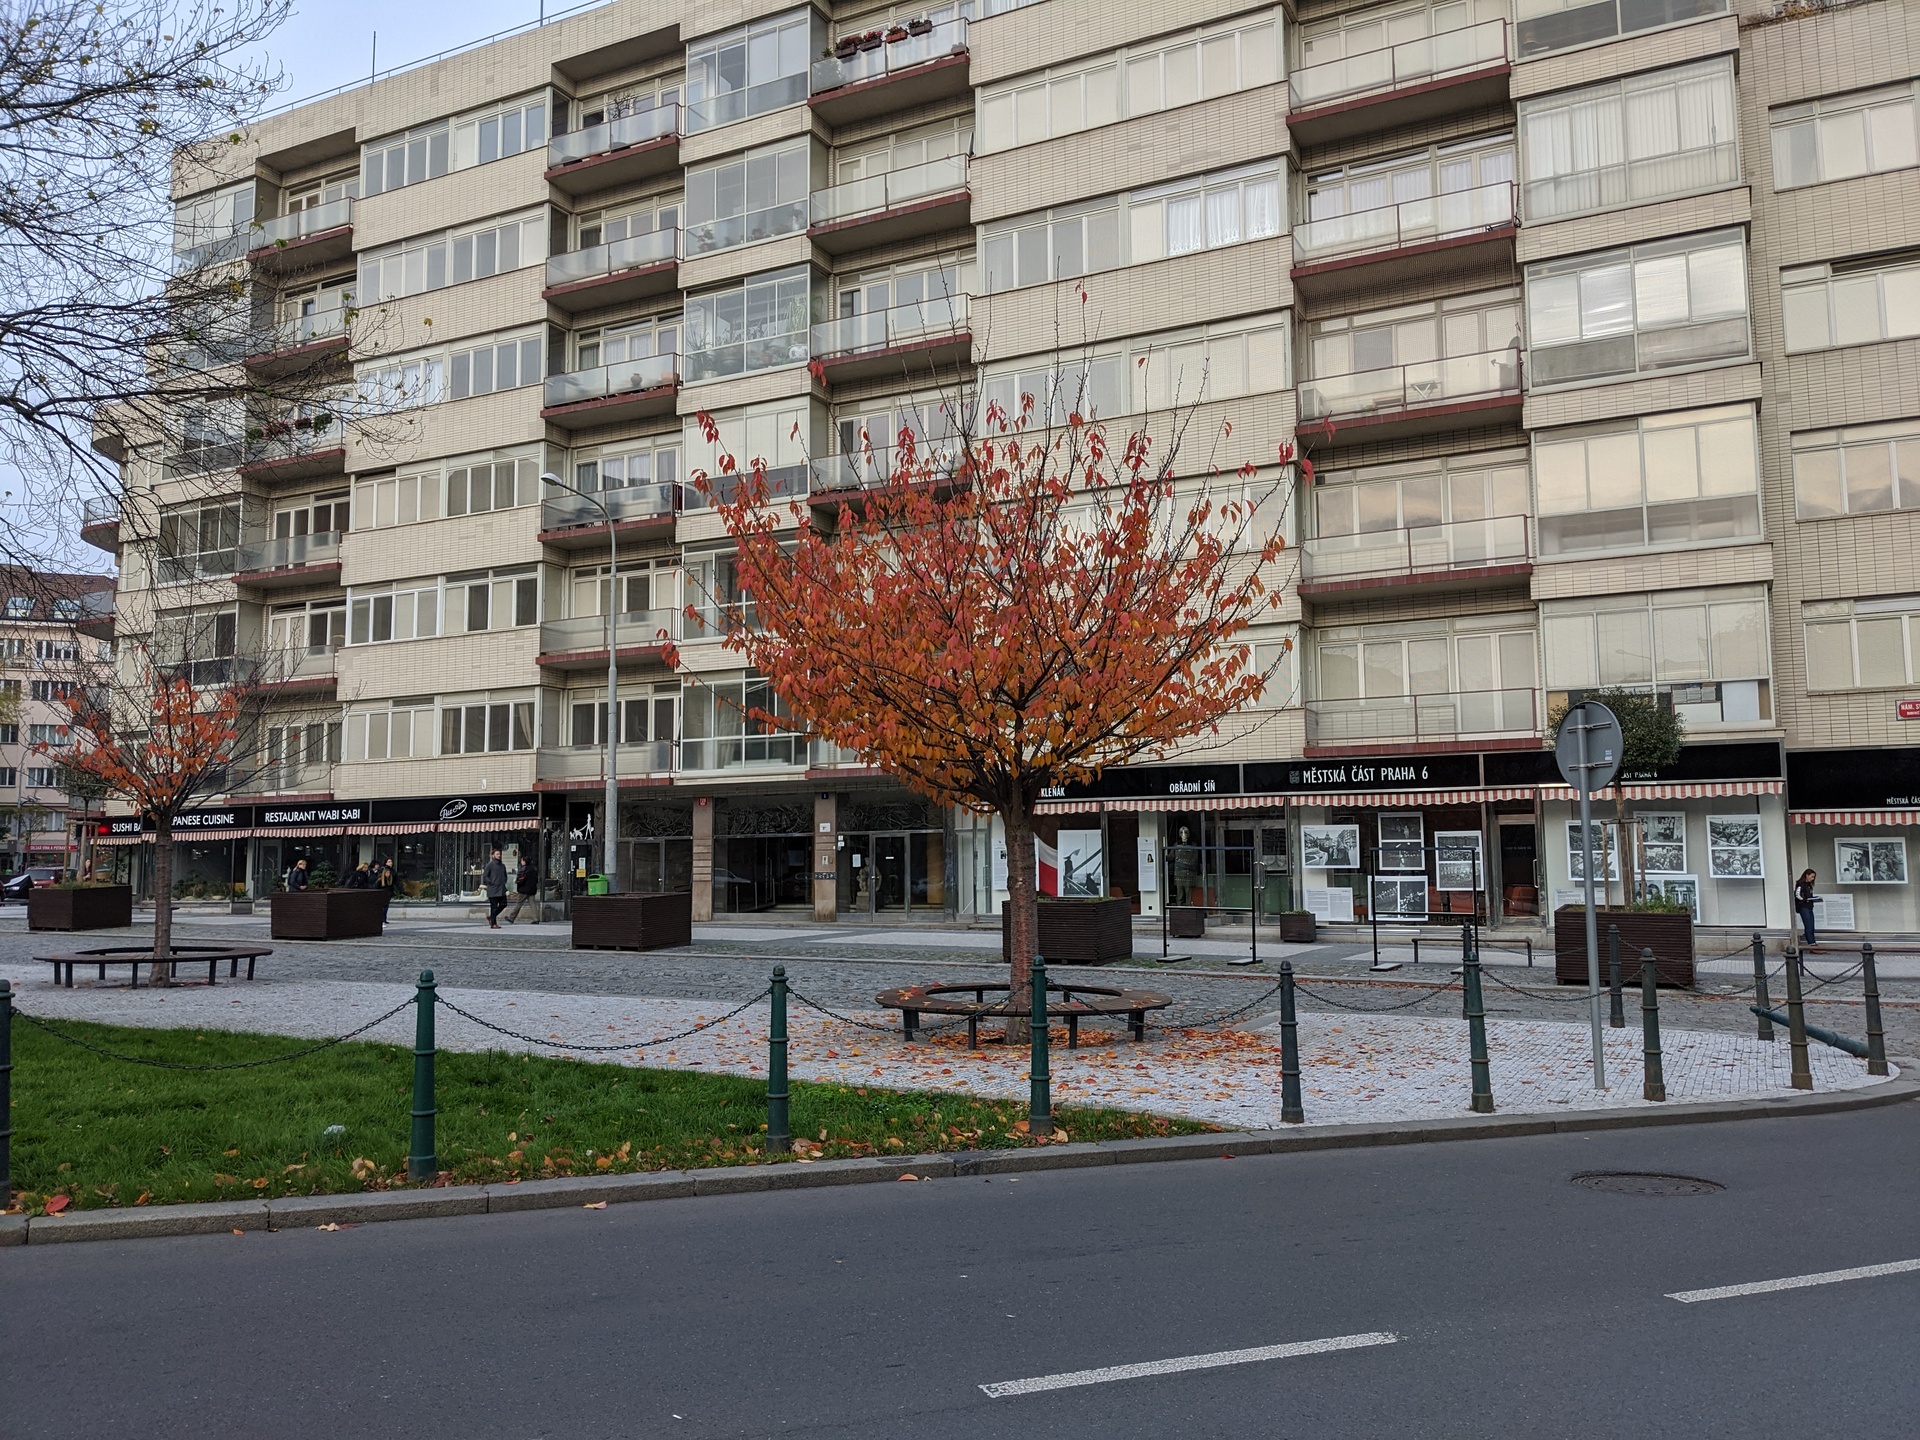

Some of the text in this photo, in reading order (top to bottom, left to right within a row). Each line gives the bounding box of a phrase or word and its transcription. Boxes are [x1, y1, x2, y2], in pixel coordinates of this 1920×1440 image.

[1303, 765, 1429, 784] MĚSTSKÁ ČÁST PRAHA 6
[1169, 780, 1216, 793] OBŘADNÍ SÍŇ
[1886, 796, 1910, 805] MĚSTSKÁ
[472, 804, 487, 813] PRO
[489, 802, 520, 813] STYLOVÉ
[521, 802, 537, 811] PSY
[202, 814, 235, 825] CUISINE
[265, 809, 361, 823] RESTAURANT WABI SABI
[112, 823, 133, 833] SUSHI
